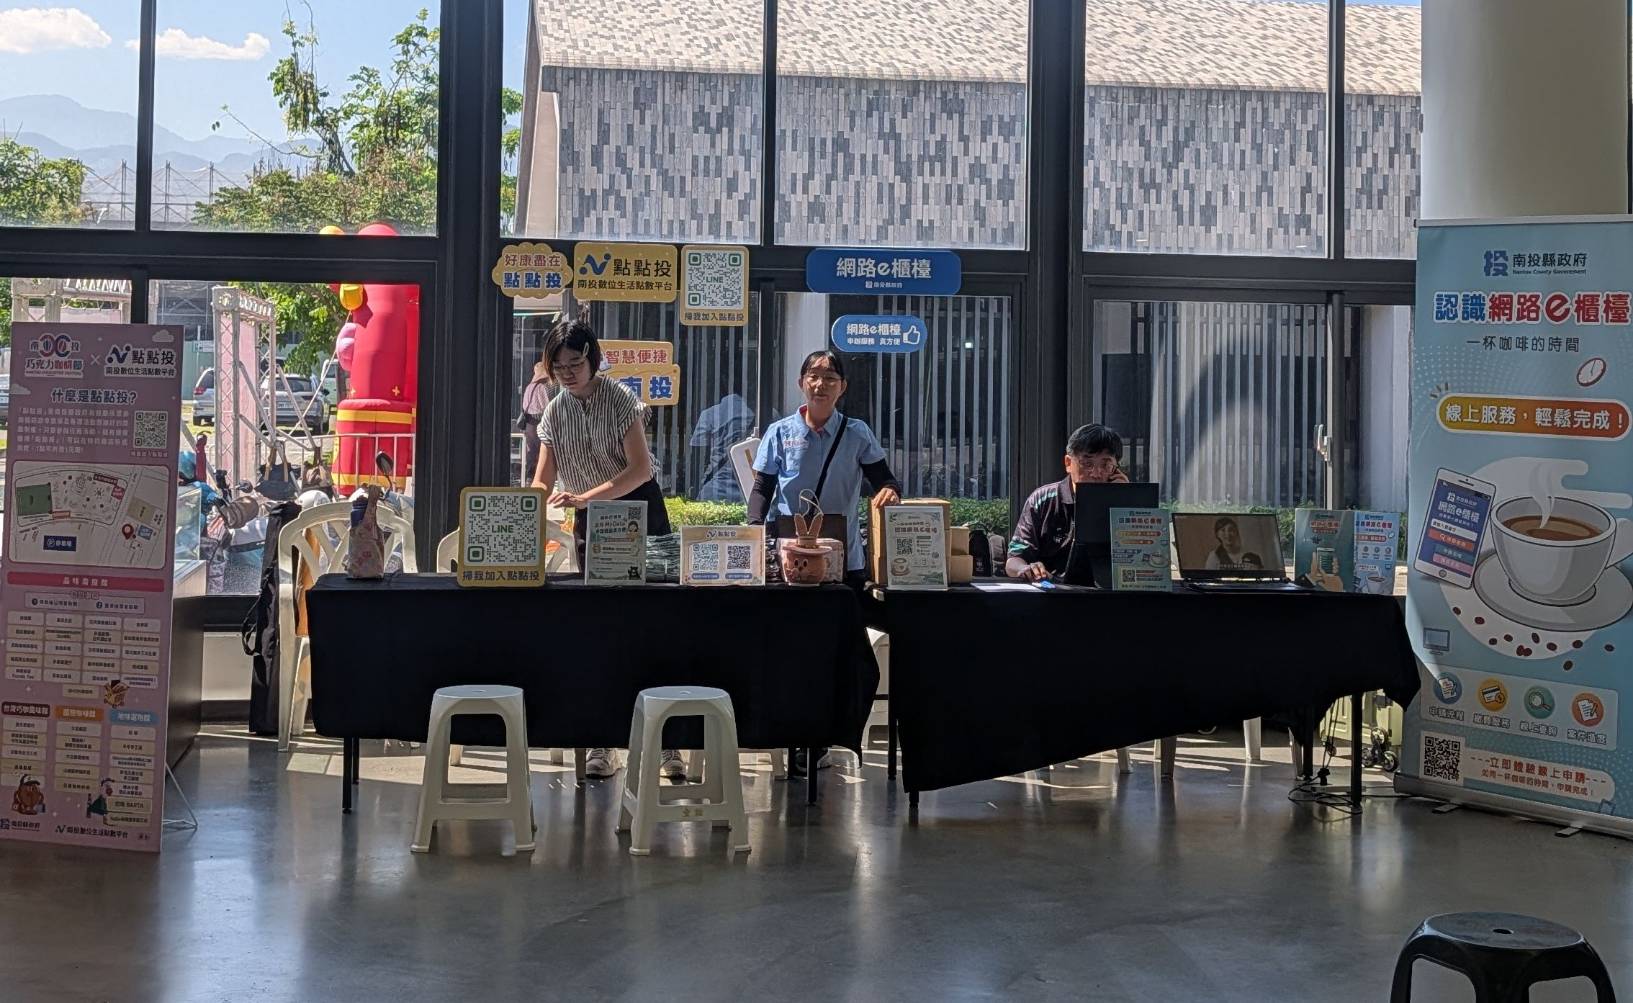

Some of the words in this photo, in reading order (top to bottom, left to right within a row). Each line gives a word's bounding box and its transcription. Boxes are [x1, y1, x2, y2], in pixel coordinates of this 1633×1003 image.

[504, 253, 561, 268] 好康盡在
[613, 258, 673, 278] 點點投
[836, 257, 932, 279] 網路e櫃檯
[1513, 253, 1587, 268] 南投縣政府
[503, 272, 562, 289] 點點投
[577, 279, 673, 292] 南投數位生活點數平台
[705, 276, 725, 284] LINE
[1434, 292, 1630, 324] 認識網路e櫃檯
[846, 323, 902, 335] 網路e櫃檯
[1467, 336, 1580, 353] 一杯咖啡的時間
[131, 350, 175, 366] 點點投
[605, 349, 667, 364] 智慧便捷
[105, 366, 175, 377] 南投數位生活點數平台
[491, 524, 514, 534] LINE
[462, 570, 541, 582] 掃我加入點點投
[1490, 757, 1586, 784] 立即體驗線上申請
